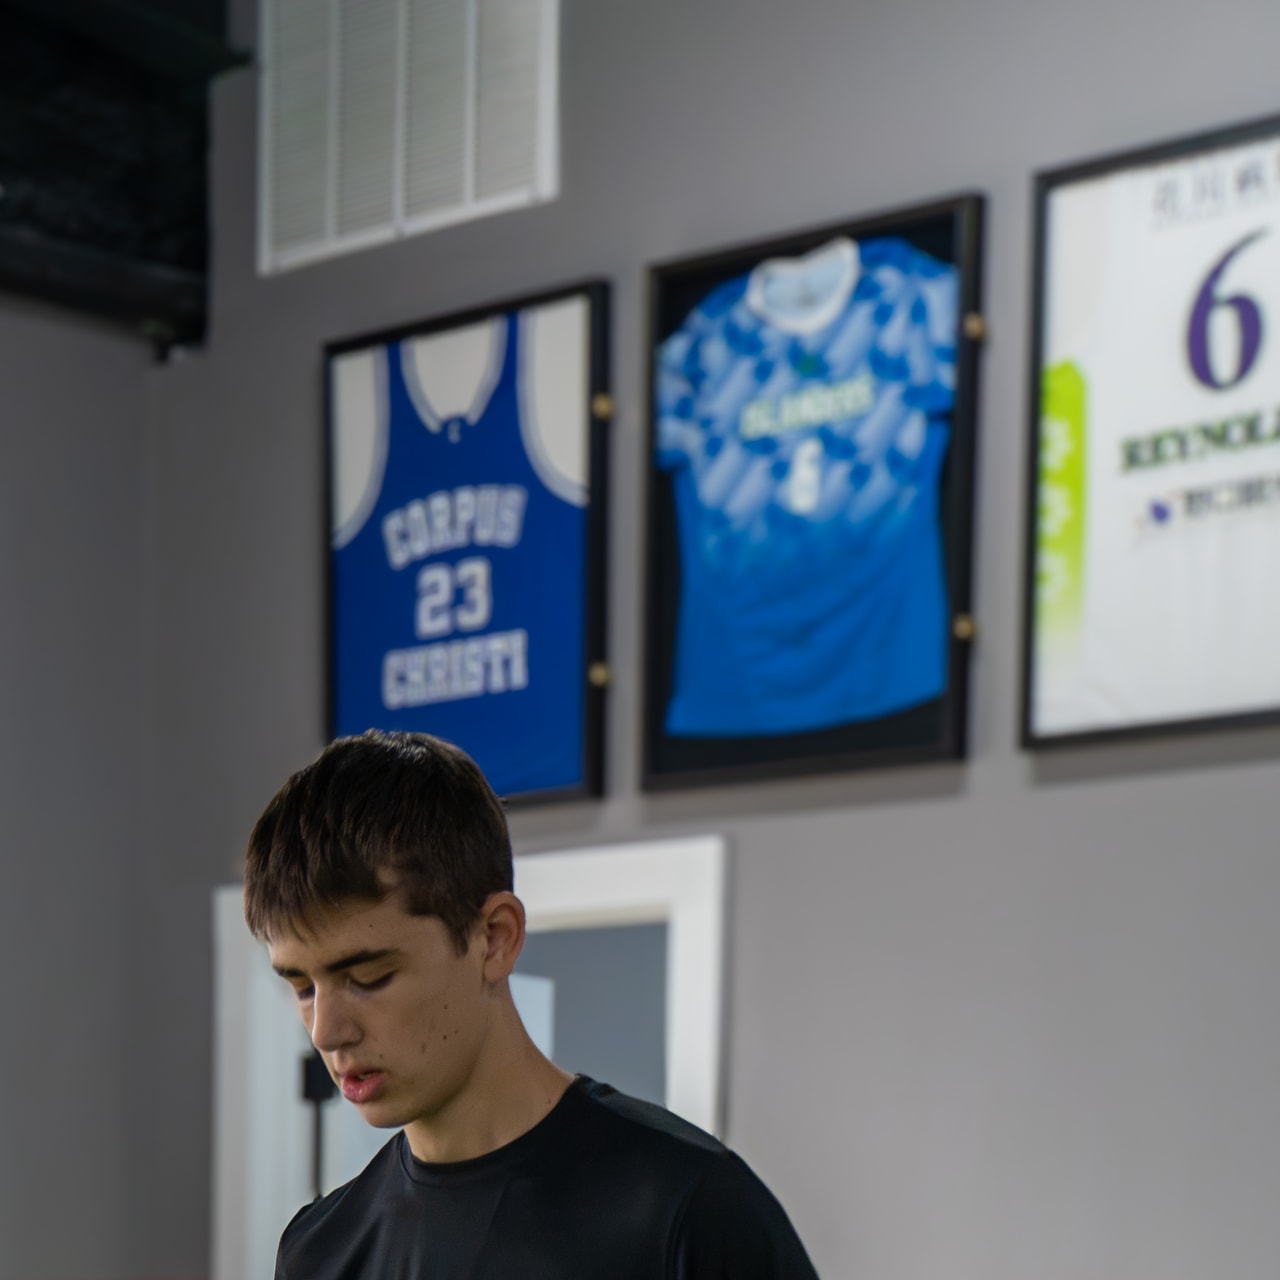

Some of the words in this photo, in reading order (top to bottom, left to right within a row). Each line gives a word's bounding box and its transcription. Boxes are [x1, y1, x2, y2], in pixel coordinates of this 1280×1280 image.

[1186, 227, 1268, 391] 6
[1119, 406, 1280, 473] REYNOL
[382, 484, 528, 570] CORPUS
[415, 556, 491, 639] 23
[382, 628, 528, 709] CHRISTI
